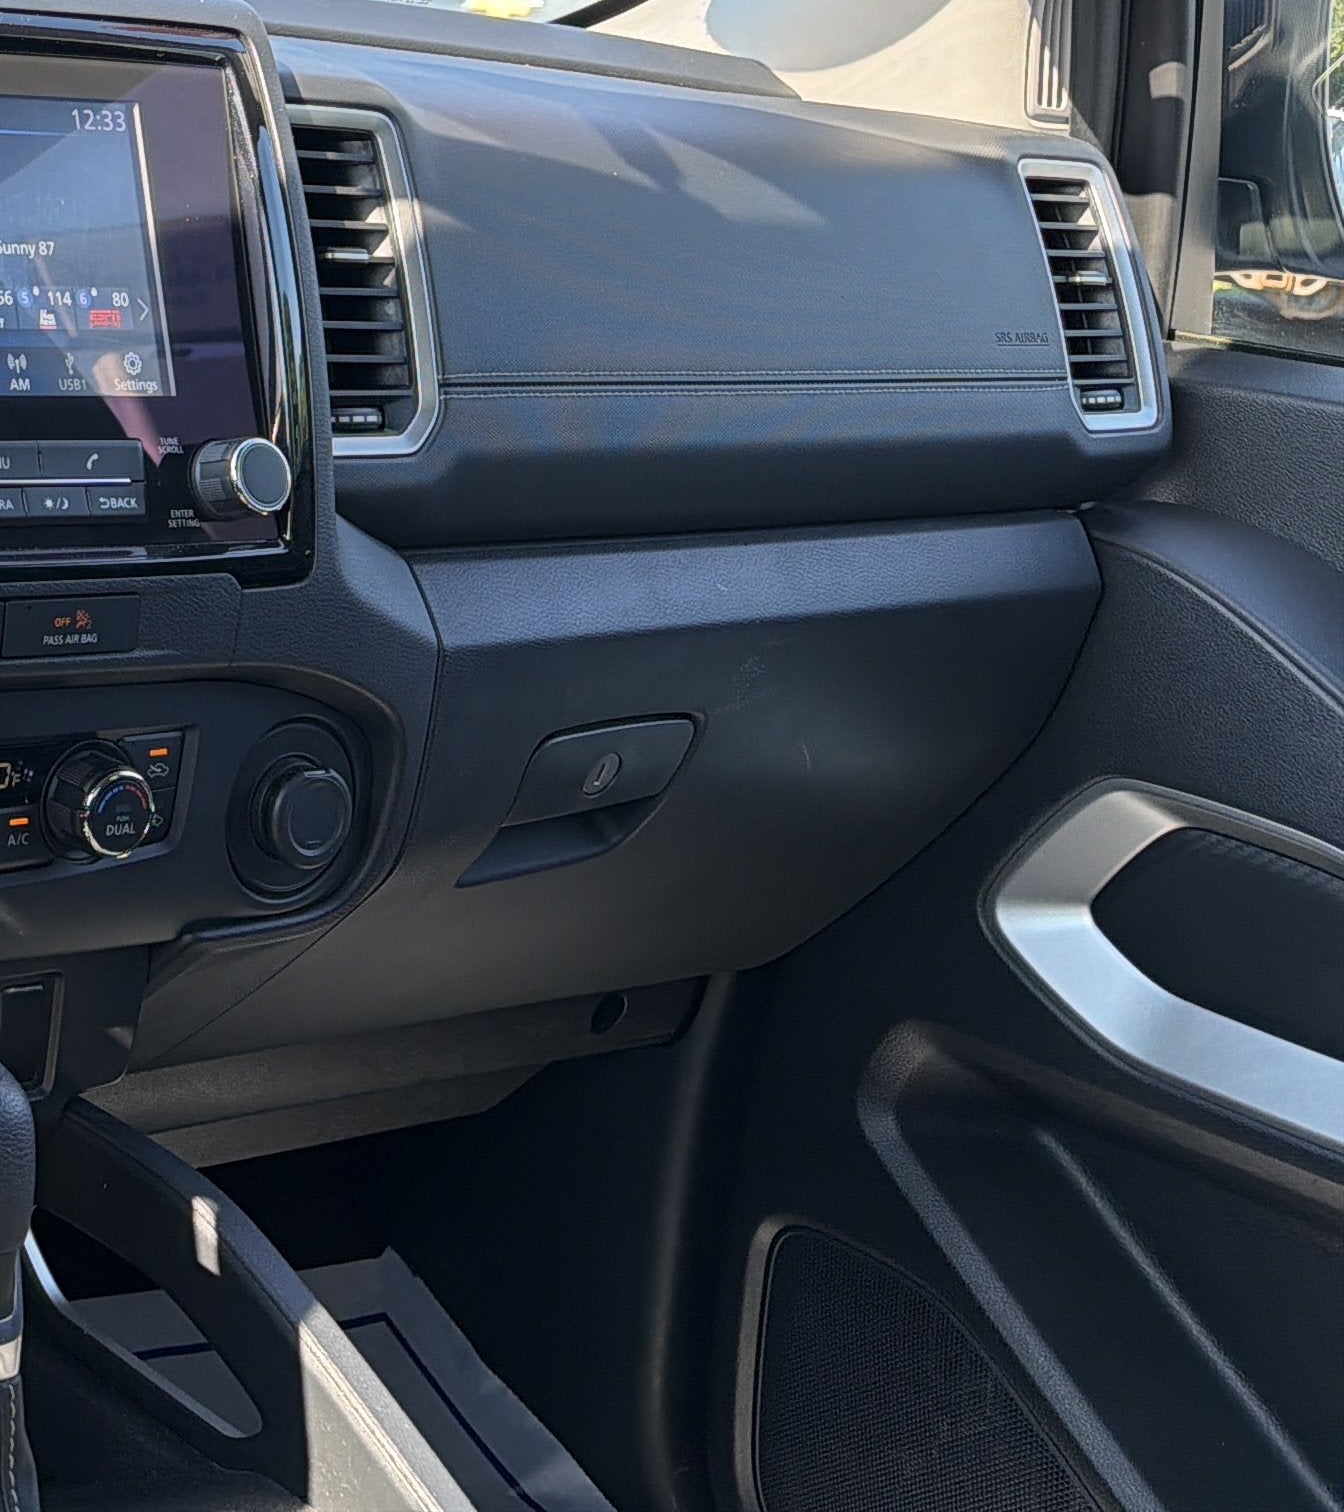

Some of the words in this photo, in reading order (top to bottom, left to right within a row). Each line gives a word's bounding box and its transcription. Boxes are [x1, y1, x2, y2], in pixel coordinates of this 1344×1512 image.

[71, 108, 127, 132] 12:33
[38, 240, 55, 256] 87
[47, 291, 72, 307] 114
[111, 292, 130, 308] 80
[995, 332, 1012, 343] SRS
[1015, 332, 1048, 344] AIRBAG
[10, 378, 31, 391] AM
[58, 379, 87, 392] USB1
[114, 377, 158, 394] Settings
[111, 496, 138, 510] BACK
[170, 509, 194, 518] ENTER
[54, 617, 72, 628] OFF
[43, 635, 63, 645] PASS
[65, 634, 81, 644] AIR
[82, 633, 98, 644] BAG
[106, 824, 136, 836] DUAL
[8, 833, 29, 847] A/C
